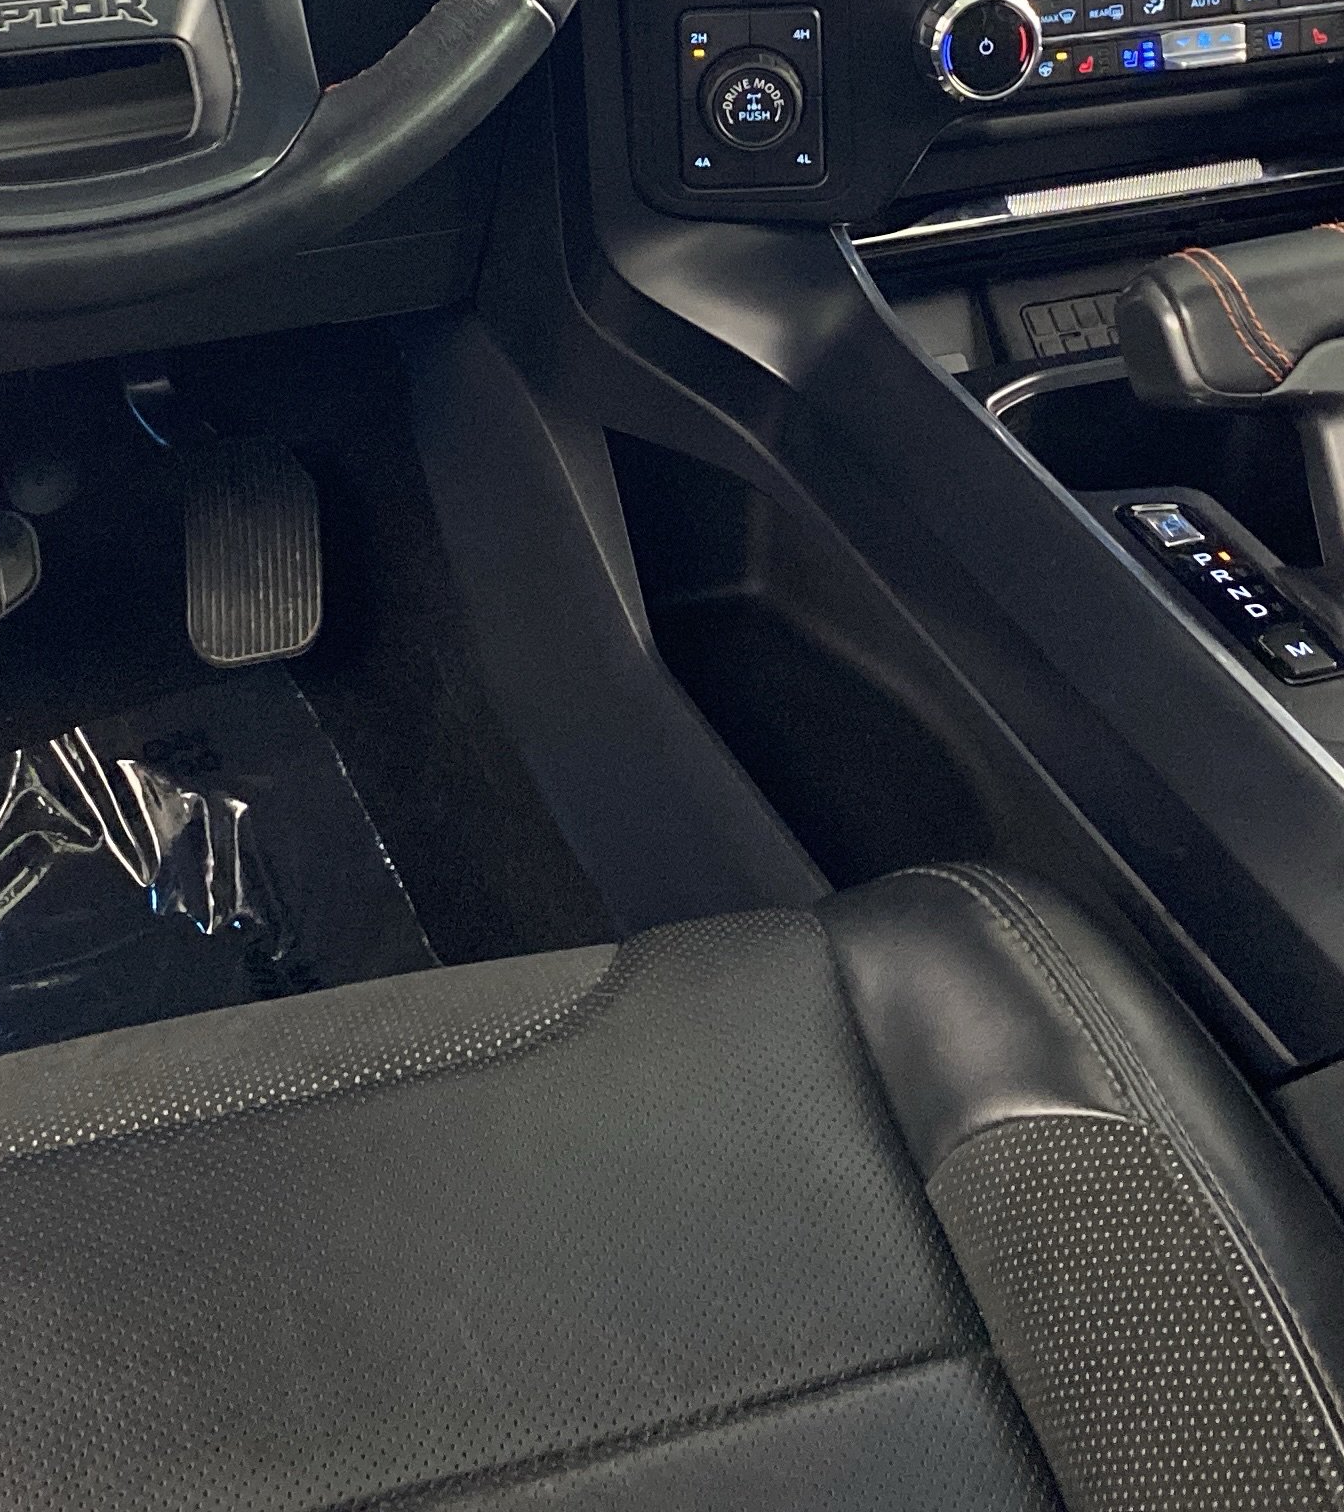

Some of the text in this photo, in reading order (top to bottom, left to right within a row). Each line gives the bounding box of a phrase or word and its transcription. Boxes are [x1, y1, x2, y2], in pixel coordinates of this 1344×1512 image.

[1089, 9, 1110, 19] REAR
[690, 33, 707, 44] 2H
[793, 29, 810, 40] 4H
[722, 77, 784, 110] DRIVE MODE
[738, 110, 771, 121] PUSH
[694, 157, 711, 168] 4A
[796, 154, 811, 165] 4L
[1193, 553, 1212, 566] P
[1210, 569, 1233, 583] R
[1227, 586, 1252, 600] N
[1244, 603, 1267, 617] D
[1285, 641, 1313, 657] M
